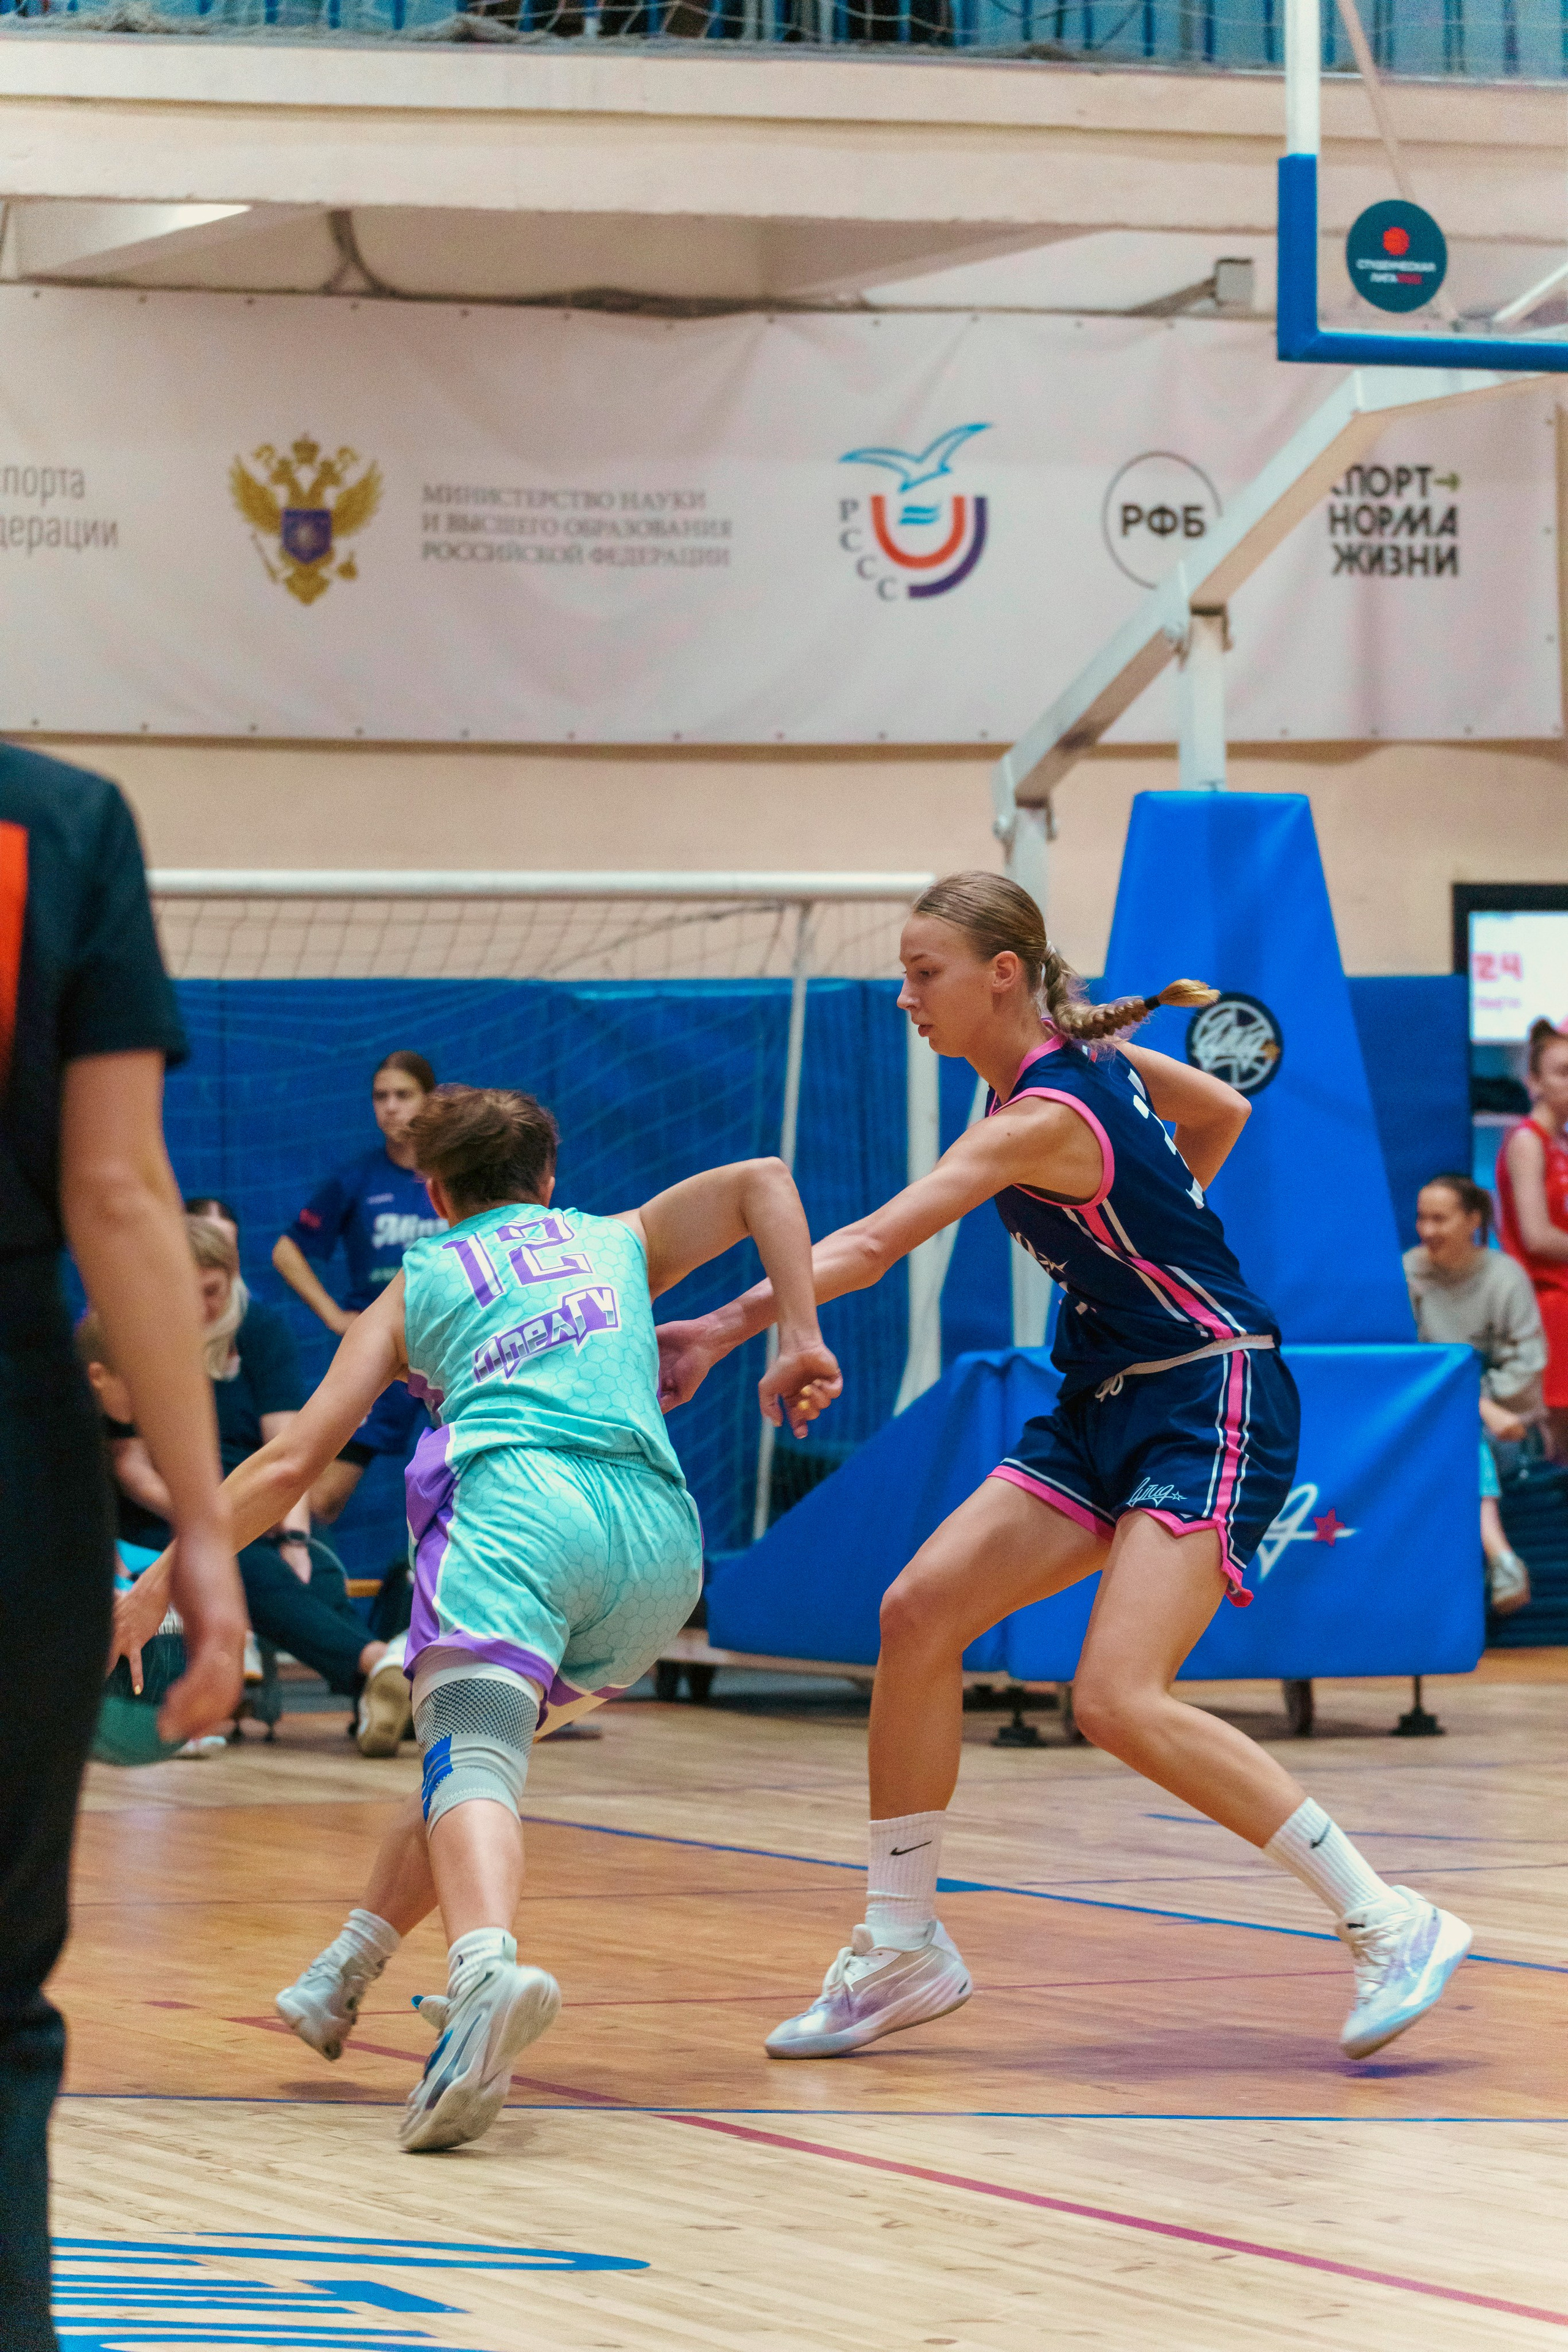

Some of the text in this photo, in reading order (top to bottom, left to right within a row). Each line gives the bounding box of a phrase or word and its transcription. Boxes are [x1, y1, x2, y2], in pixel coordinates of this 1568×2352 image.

[0, 464, 85, 507] порта
[422, 484, 706, 510] МИНИСТЕРСТВО НАУКИ
[1330, 464, 1433, 499] ПОРТ
[564, 517, 733, 538] ОБРАЗОВАНИЯ
[1120, 503, 1207, 539] РФБ
[1328, 503, 1460, 538] НОРМА
[421, 539, 730, 567] РОССИЙСКОЙ ФЕДЕРАЦИИ
[1332, 544, 1460, 578] ЖИЗНИ
[1472, 951, 1523, 981] 24
[442, 1213, 594, 1309] 12
